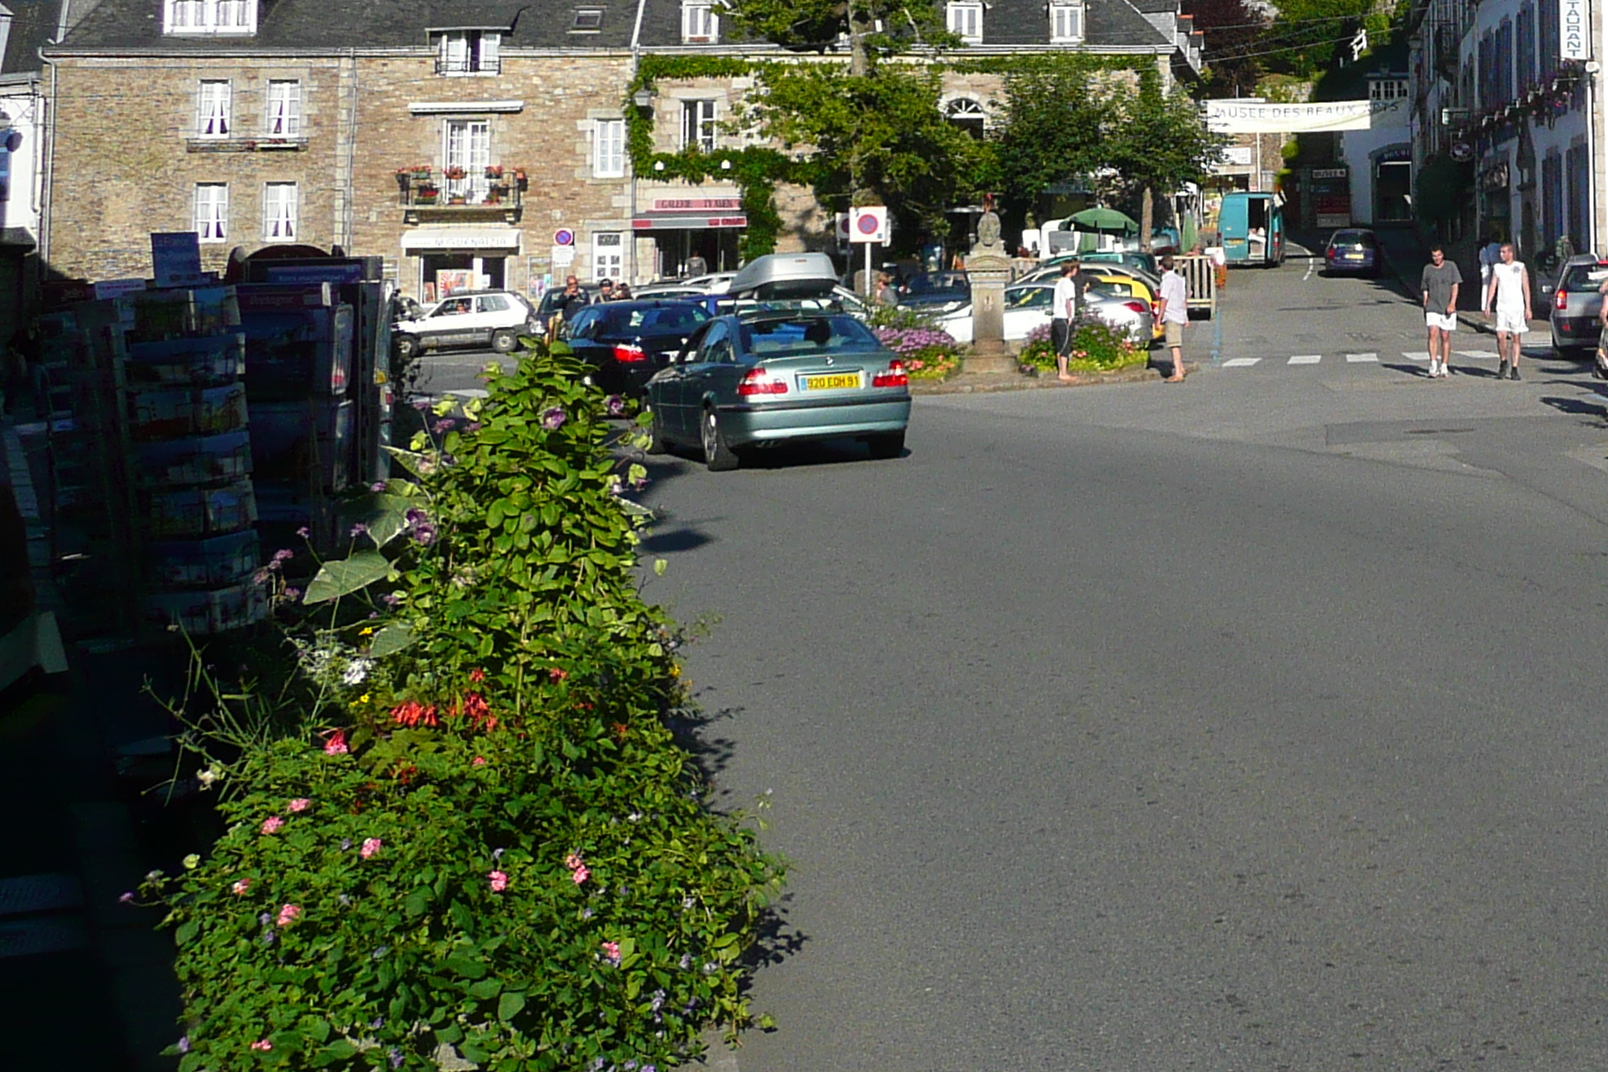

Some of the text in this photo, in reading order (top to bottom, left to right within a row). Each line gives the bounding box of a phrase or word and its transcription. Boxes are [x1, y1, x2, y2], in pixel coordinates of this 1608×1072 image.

[1215, 106, 1266, 119] MUSEE
[1272, 106, 1301, 119] DES
[1306, 104, 1356, 117] BEAUX
[249, 295, 295, 307] Bretagne
[807, 377, 825, 388] 920
[847, 375, 859, 386] 91
